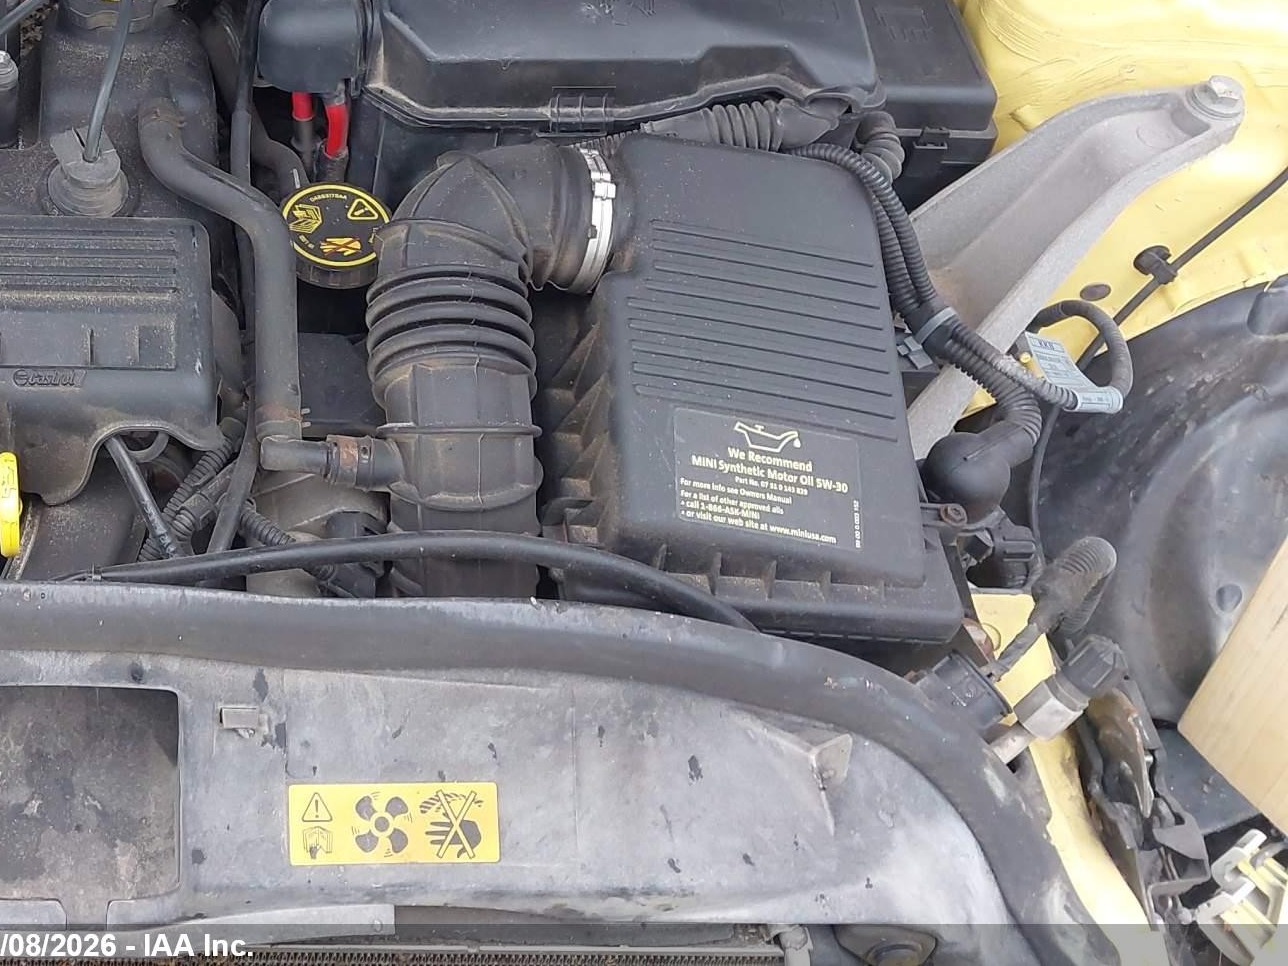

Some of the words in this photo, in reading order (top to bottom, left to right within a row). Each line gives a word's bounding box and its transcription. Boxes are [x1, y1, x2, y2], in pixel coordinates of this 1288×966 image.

[728, 446, 746, 460] We
[748, 450, 812, 472] Recommend
[692, 454, 717, 469] MINI
[718, 460, 766, 477] Synthetic
[767, 468, 798, 483] Motor
[800, 474, 814, 486] Oil
[816, 478, 848, 493] 5W-30
[735, 476, 748, 484] Part
[680, 478, 691, 486] For
[692, 481, 711, 490] more
[740, 488, 766, 499] Owners
[767, 492, 792, 504] Manual
[680, 490, 692, 498] For
[719, 496, 738, 506] other
[739, 501, 771, 512] approved
[686, 500, 699, 509] call
[696, 511, 712, 521] visit
[713, 515, 726, 523] our
[728, 517, 744, 526] web
[745, 520, 759, 530] site
[760, 523, 768, 531] at
[769, 524, 836, 544] www.miniusa.com
